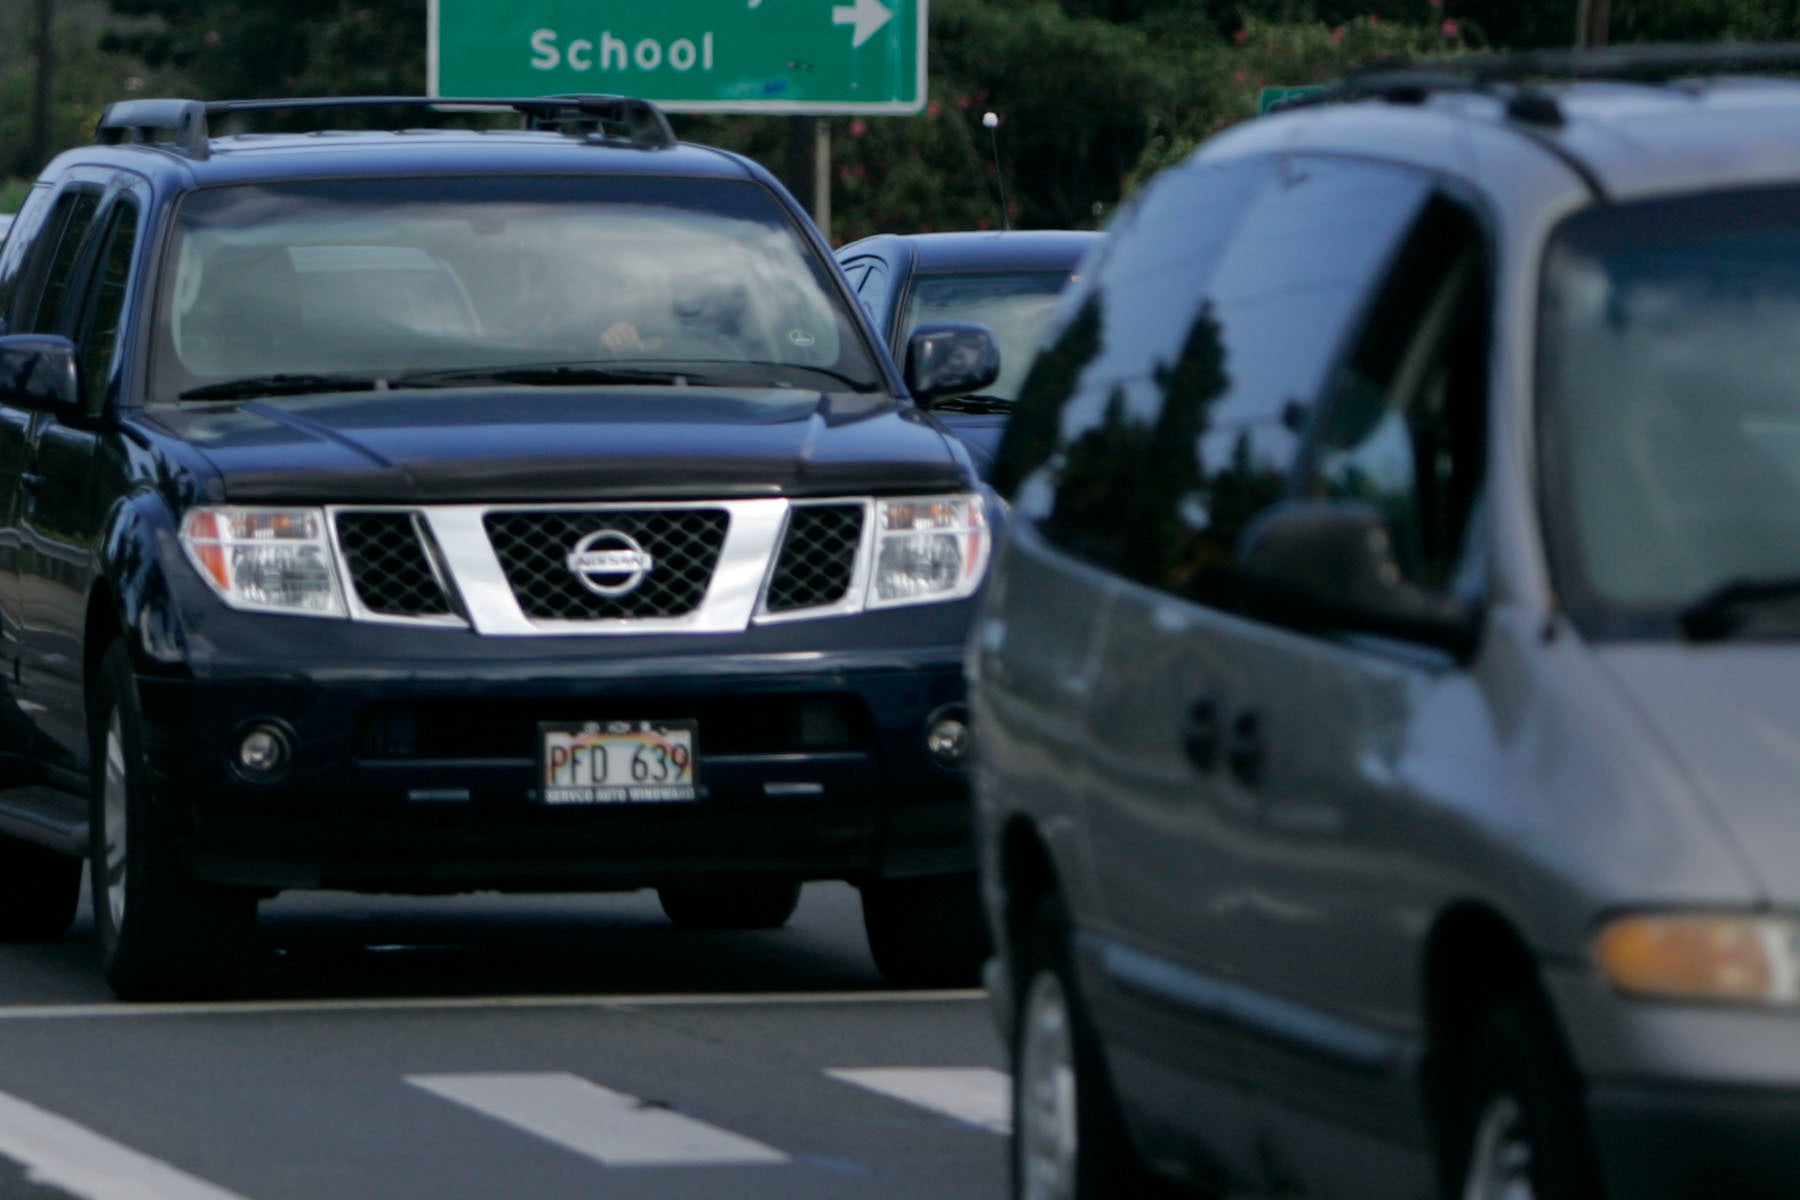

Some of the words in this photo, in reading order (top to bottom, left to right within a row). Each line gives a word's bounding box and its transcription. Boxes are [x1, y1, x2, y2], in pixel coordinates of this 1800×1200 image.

[529, 28, 714, 71] School
[551, 744, 608, 784] PFD
[631, 743, 690, 782] 639
